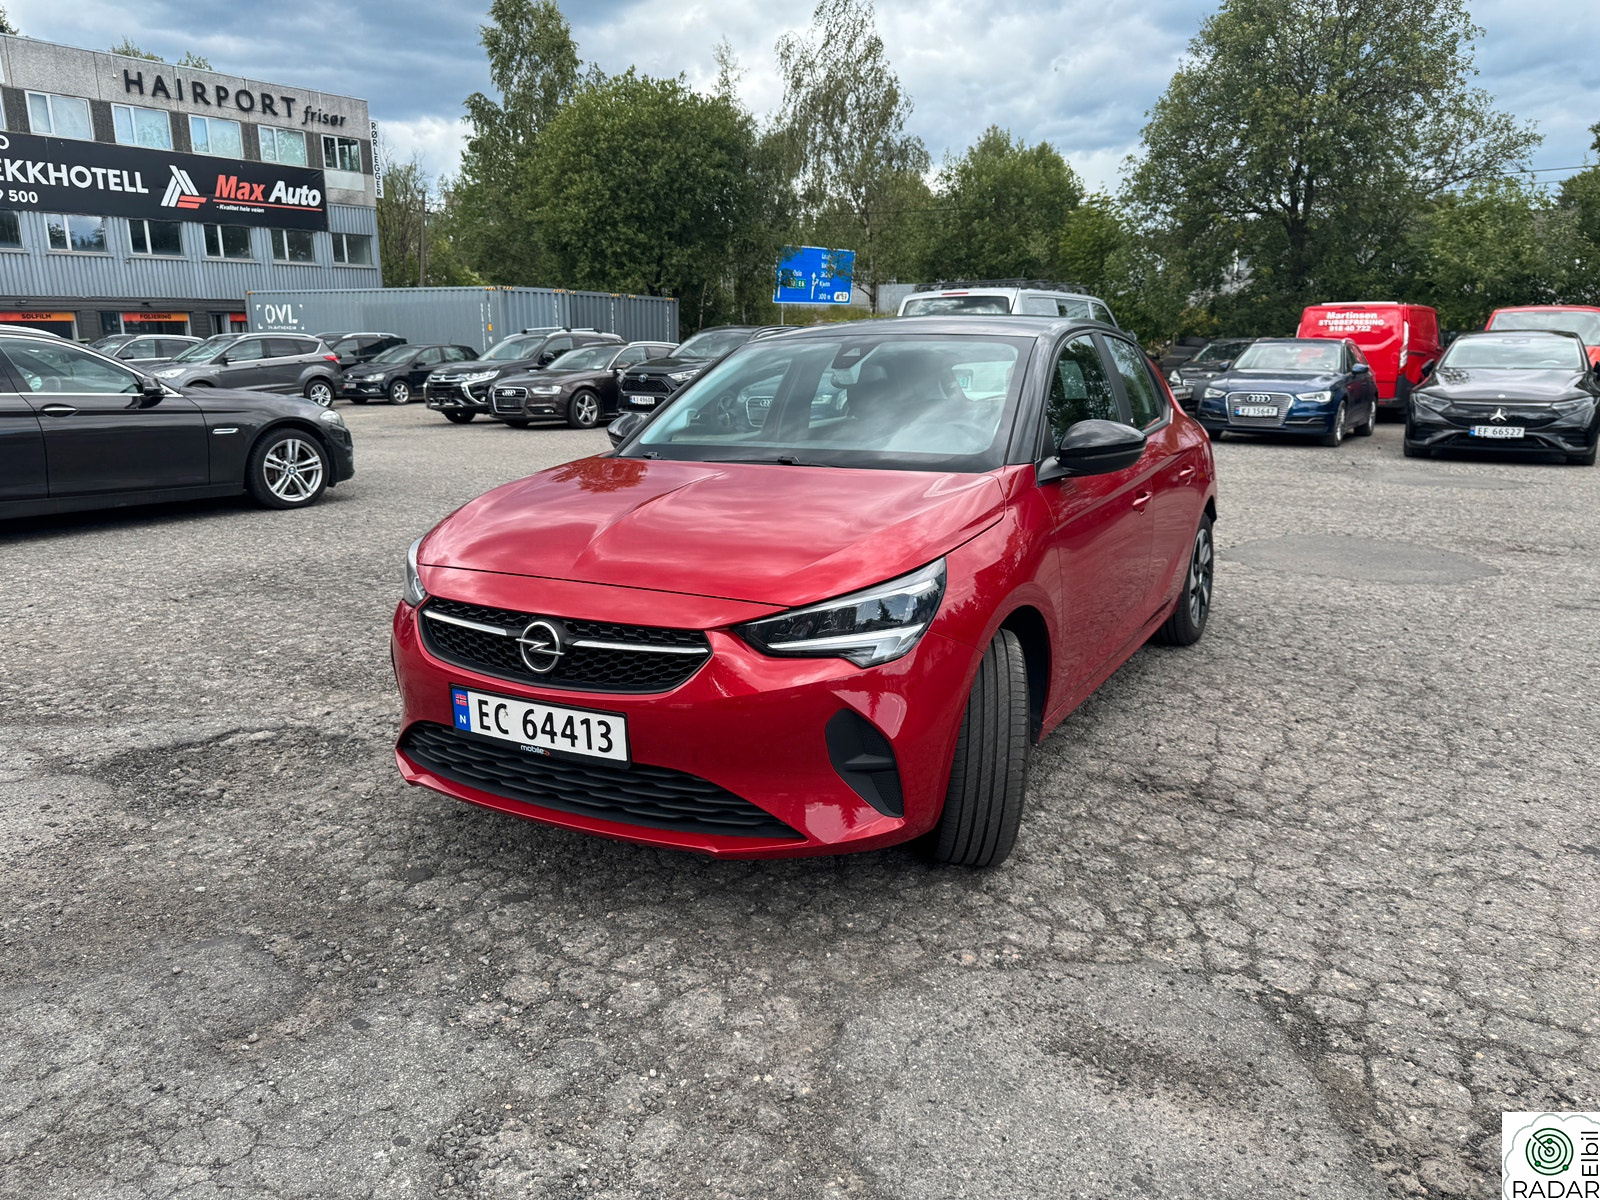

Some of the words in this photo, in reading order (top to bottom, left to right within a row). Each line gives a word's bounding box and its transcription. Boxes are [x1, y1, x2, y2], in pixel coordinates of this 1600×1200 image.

[123, 69, 296, 118] HAIRPORT
[302, 105, 346, 127] frisør
[0, 158, 149, 194] KKHOTELL
[370, 121, 382, 197] RØRLEGGER
[8, 189, 39, 204] 500
[214, 174, 265, 201] Max
[268, 180, 321, 207] Auto
[1492, 427, 1522, 435] 66527
[459, 714, 467, 725] N
[478, 698, 509, 735] EC
[522, 708, 613, 753] 64413
